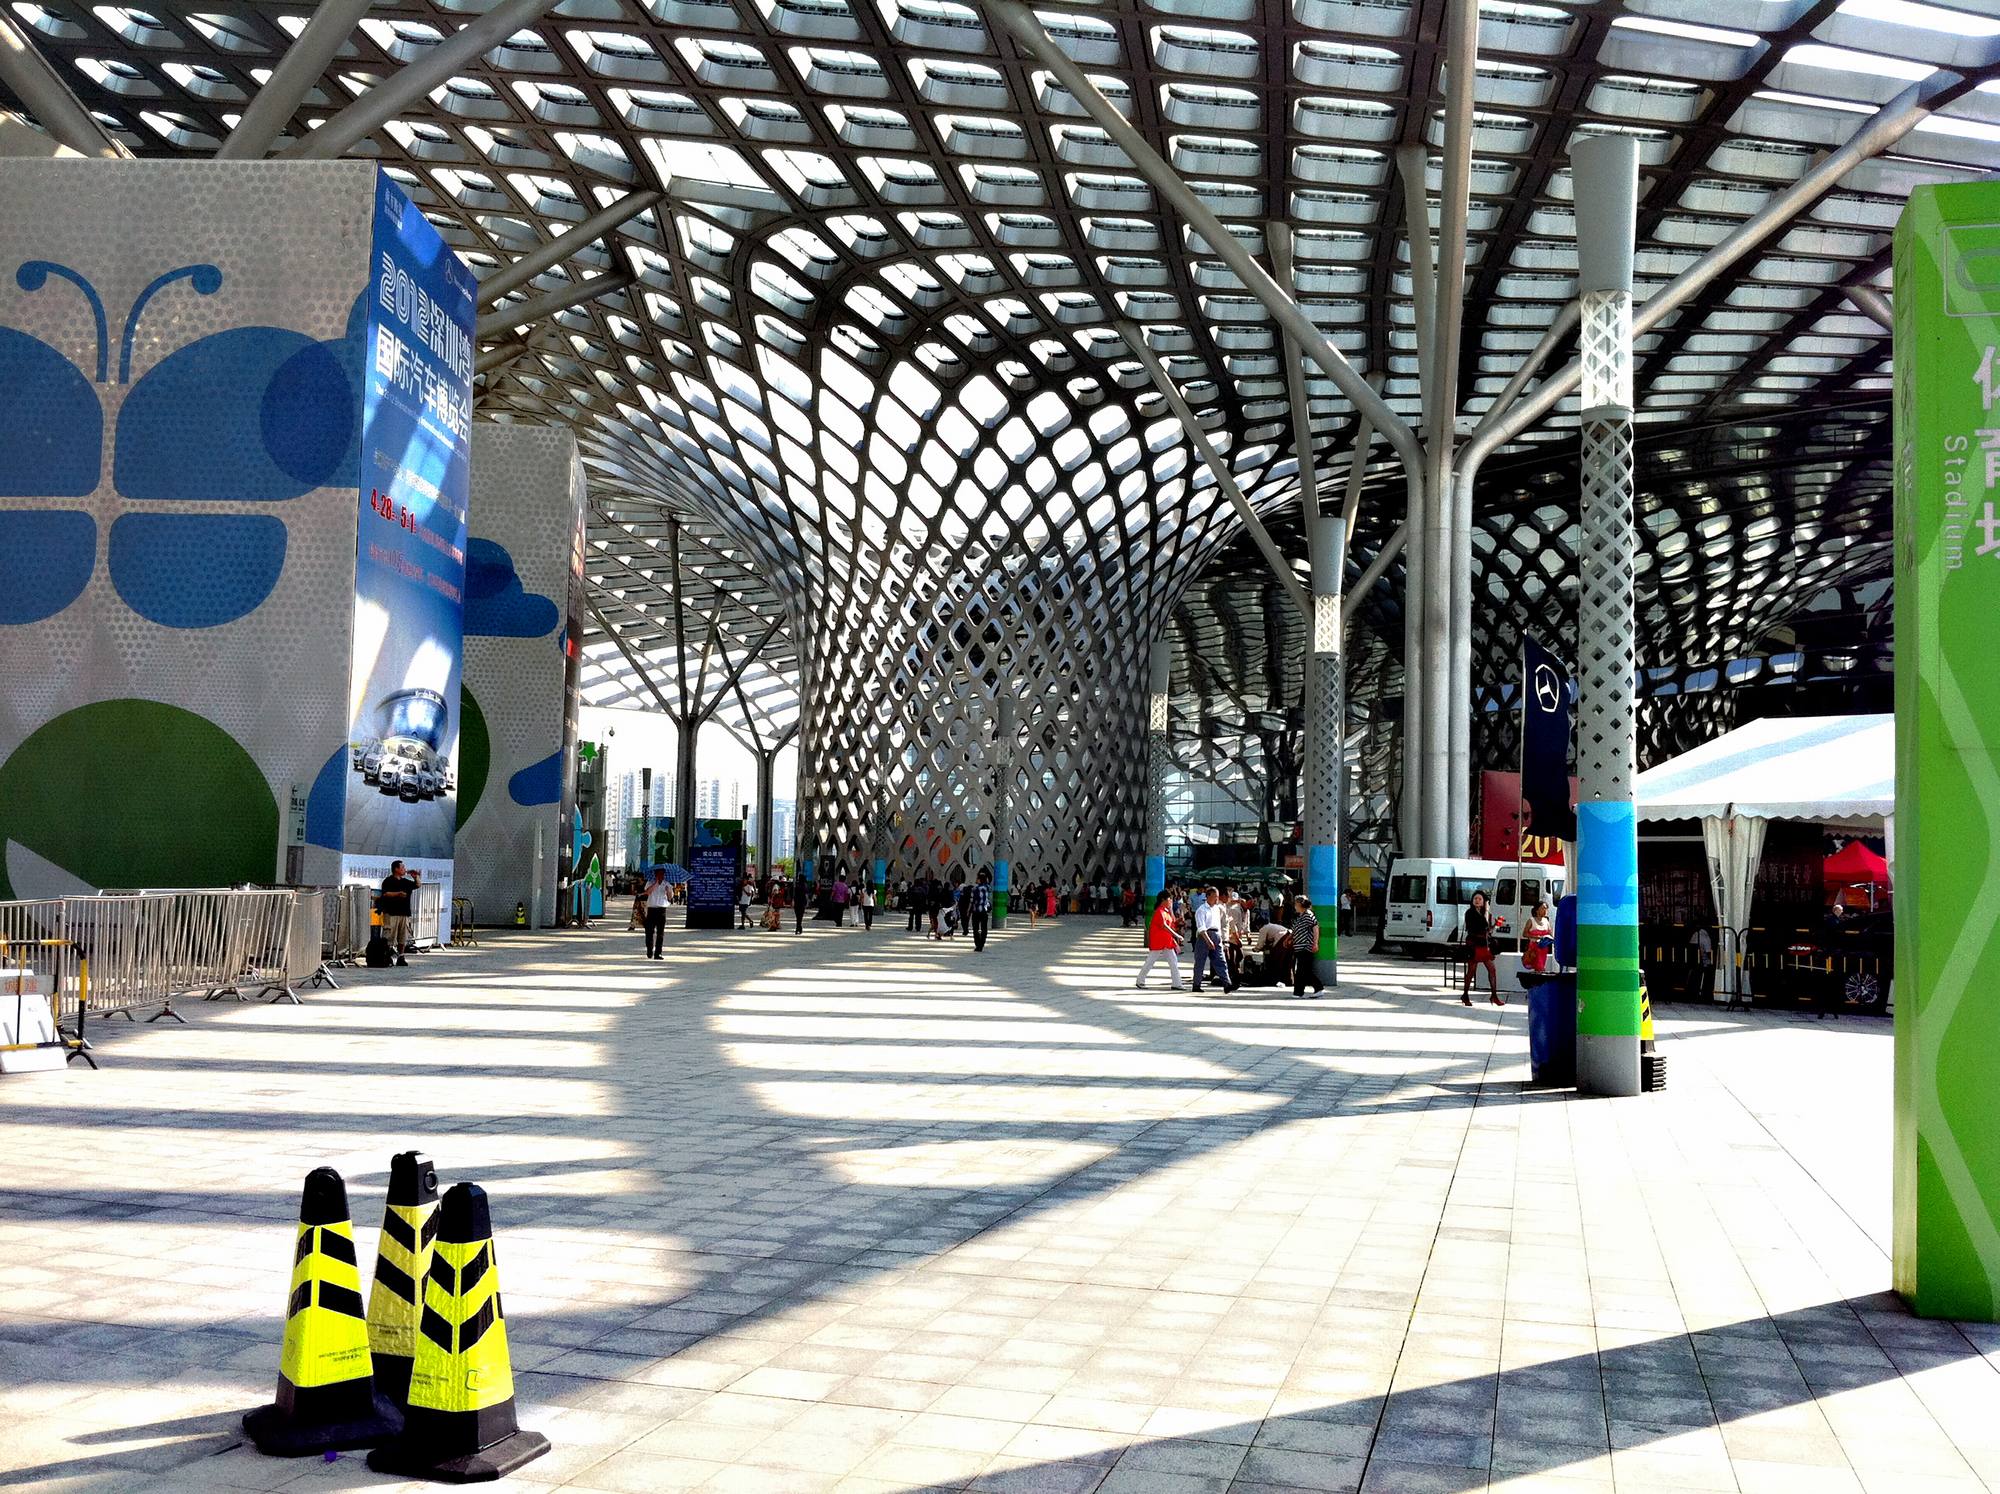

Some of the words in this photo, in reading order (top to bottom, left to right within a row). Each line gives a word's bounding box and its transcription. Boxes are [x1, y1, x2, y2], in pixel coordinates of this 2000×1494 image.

[376, 323, 469, 444] 国际汽车博览会
[380, 250, 471, 387] 2012深圳湾
[1944, 435, 1968, 570] Stadium
